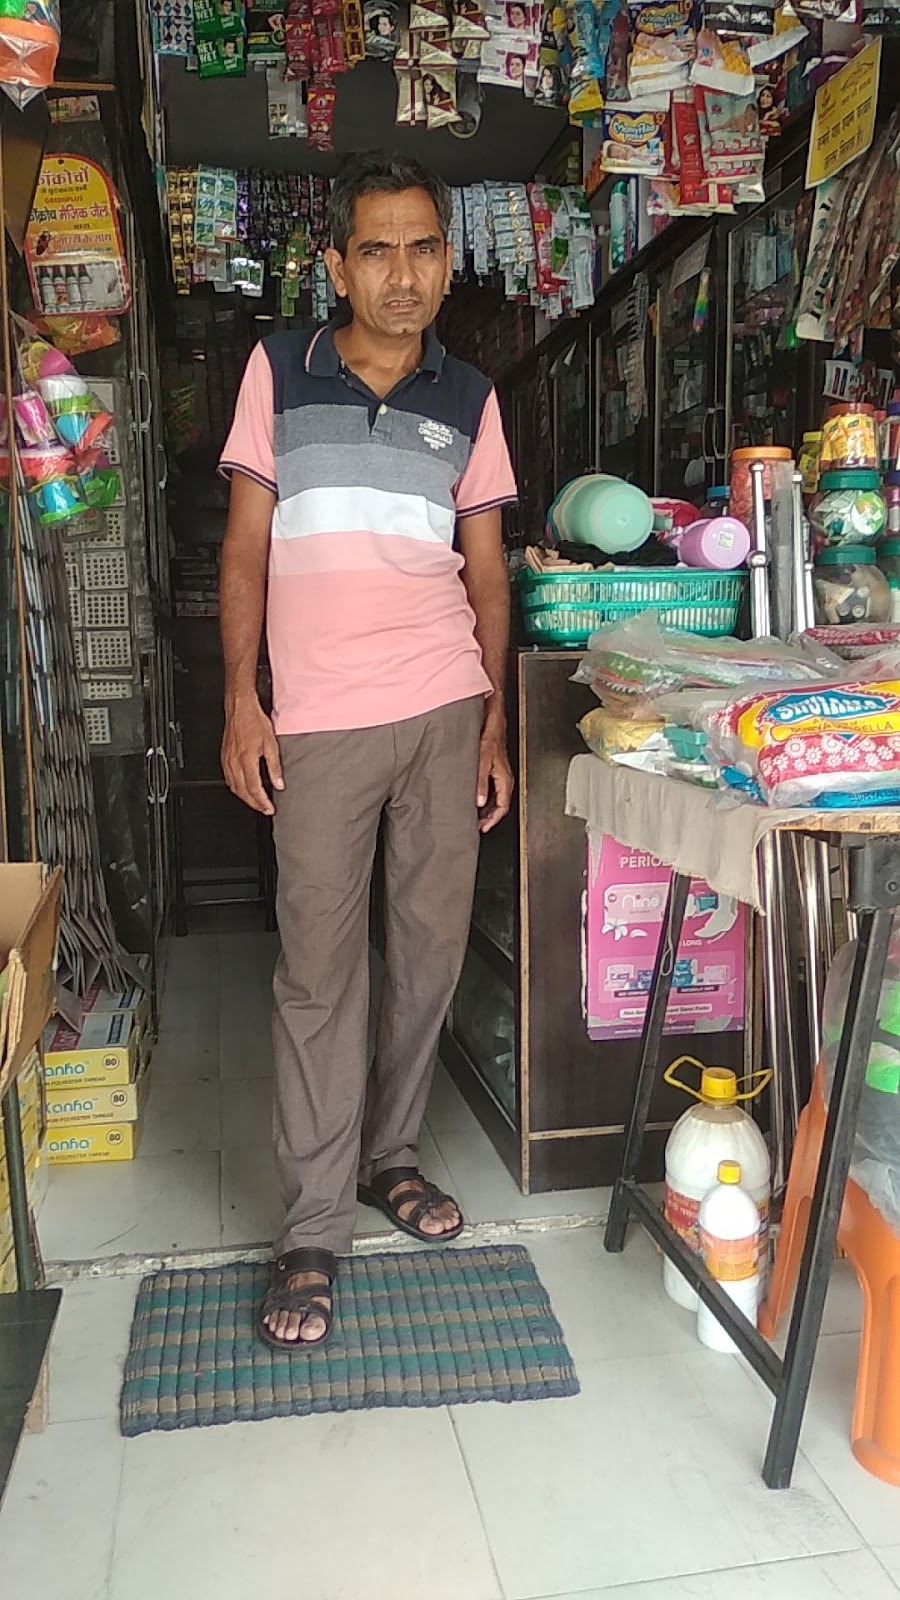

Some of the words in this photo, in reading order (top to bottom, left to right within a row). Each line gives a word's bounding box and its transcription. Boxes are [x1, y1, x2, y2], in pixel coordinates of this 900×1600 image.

[196, 7, 214, 20] WET
[197, 41, 214, 54] SET
[199, 50, 217, 63] WET
[620, 855, 673, 869] PERIO
[44, 1063, 85, 1077] anha
[105, 1058, 117, 1066] 80
[51, 1078, 82, 1086] POLYESTER
[113, 1094, 125, 1102] 80
[49, 1138, 90, 1151] anha
[109, 1133, 121, 1141] 80
